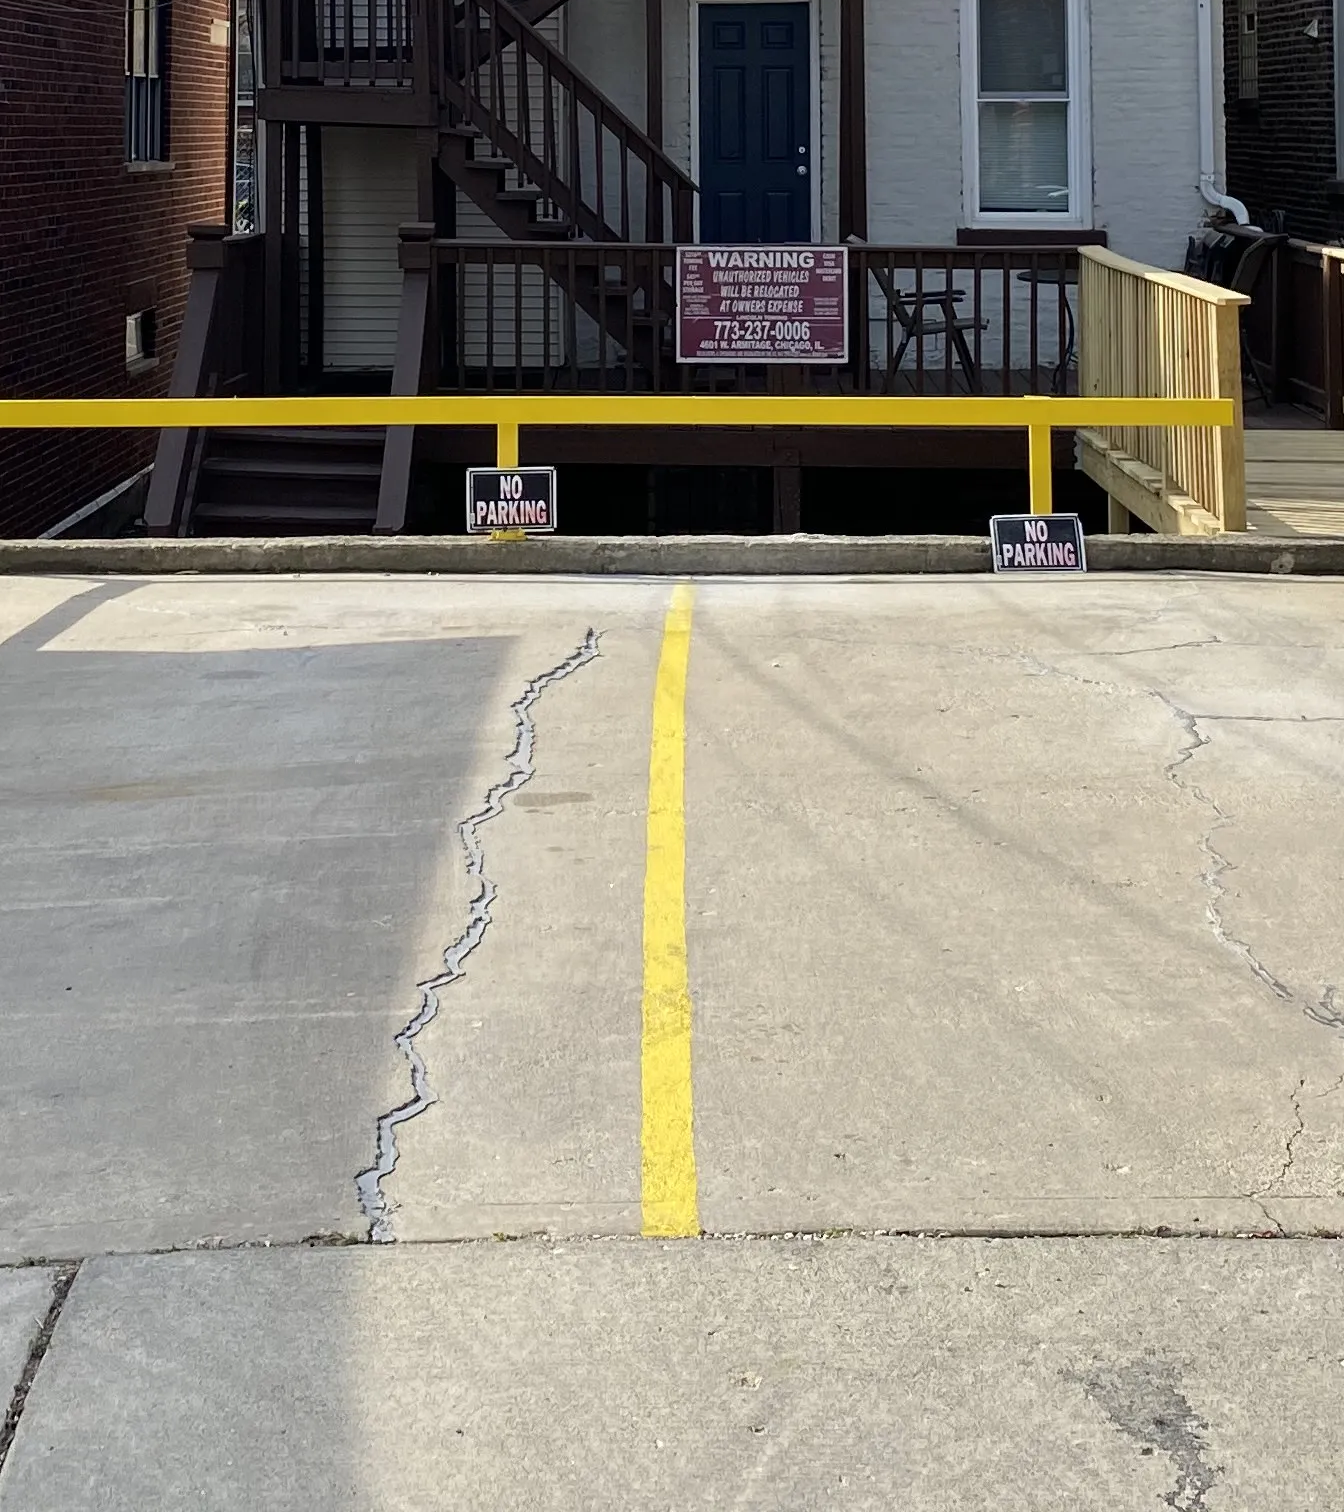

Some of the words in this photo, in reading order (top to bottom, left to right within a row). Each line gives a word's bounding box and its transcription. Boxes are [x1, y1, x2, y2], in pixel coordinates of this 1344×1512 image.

[708, 251, 815, 268] WARNING
[713, 271, 772, 283] UNAUTHORIZED
[773, 271, 810, 283] VEHICLES
[720, 285, 739, 298] WILL
[741, 285, 752, 298] BE
[753, 285, 800, 298] RELOCATED
[720, 300, 731, 313] AT
[732, 300, 766, 313] OWNERS
[767, 300, 804, 313] EXPENSE
[714, 321, 810, 340] 773-237-0006
[699, 340, 718, 349] 4601
[720, 340, 729, 348] W.
[731, 340, 773, 350] ARMITAGE,
[775, 340, 813, 351] CHICAGO,
[499, 475, 523, 500] NO
[476, 500, 547, 525] PARKING
[1024, 520, 1049, 542] NO
[1002, 542, 1076, 567] PARKING
